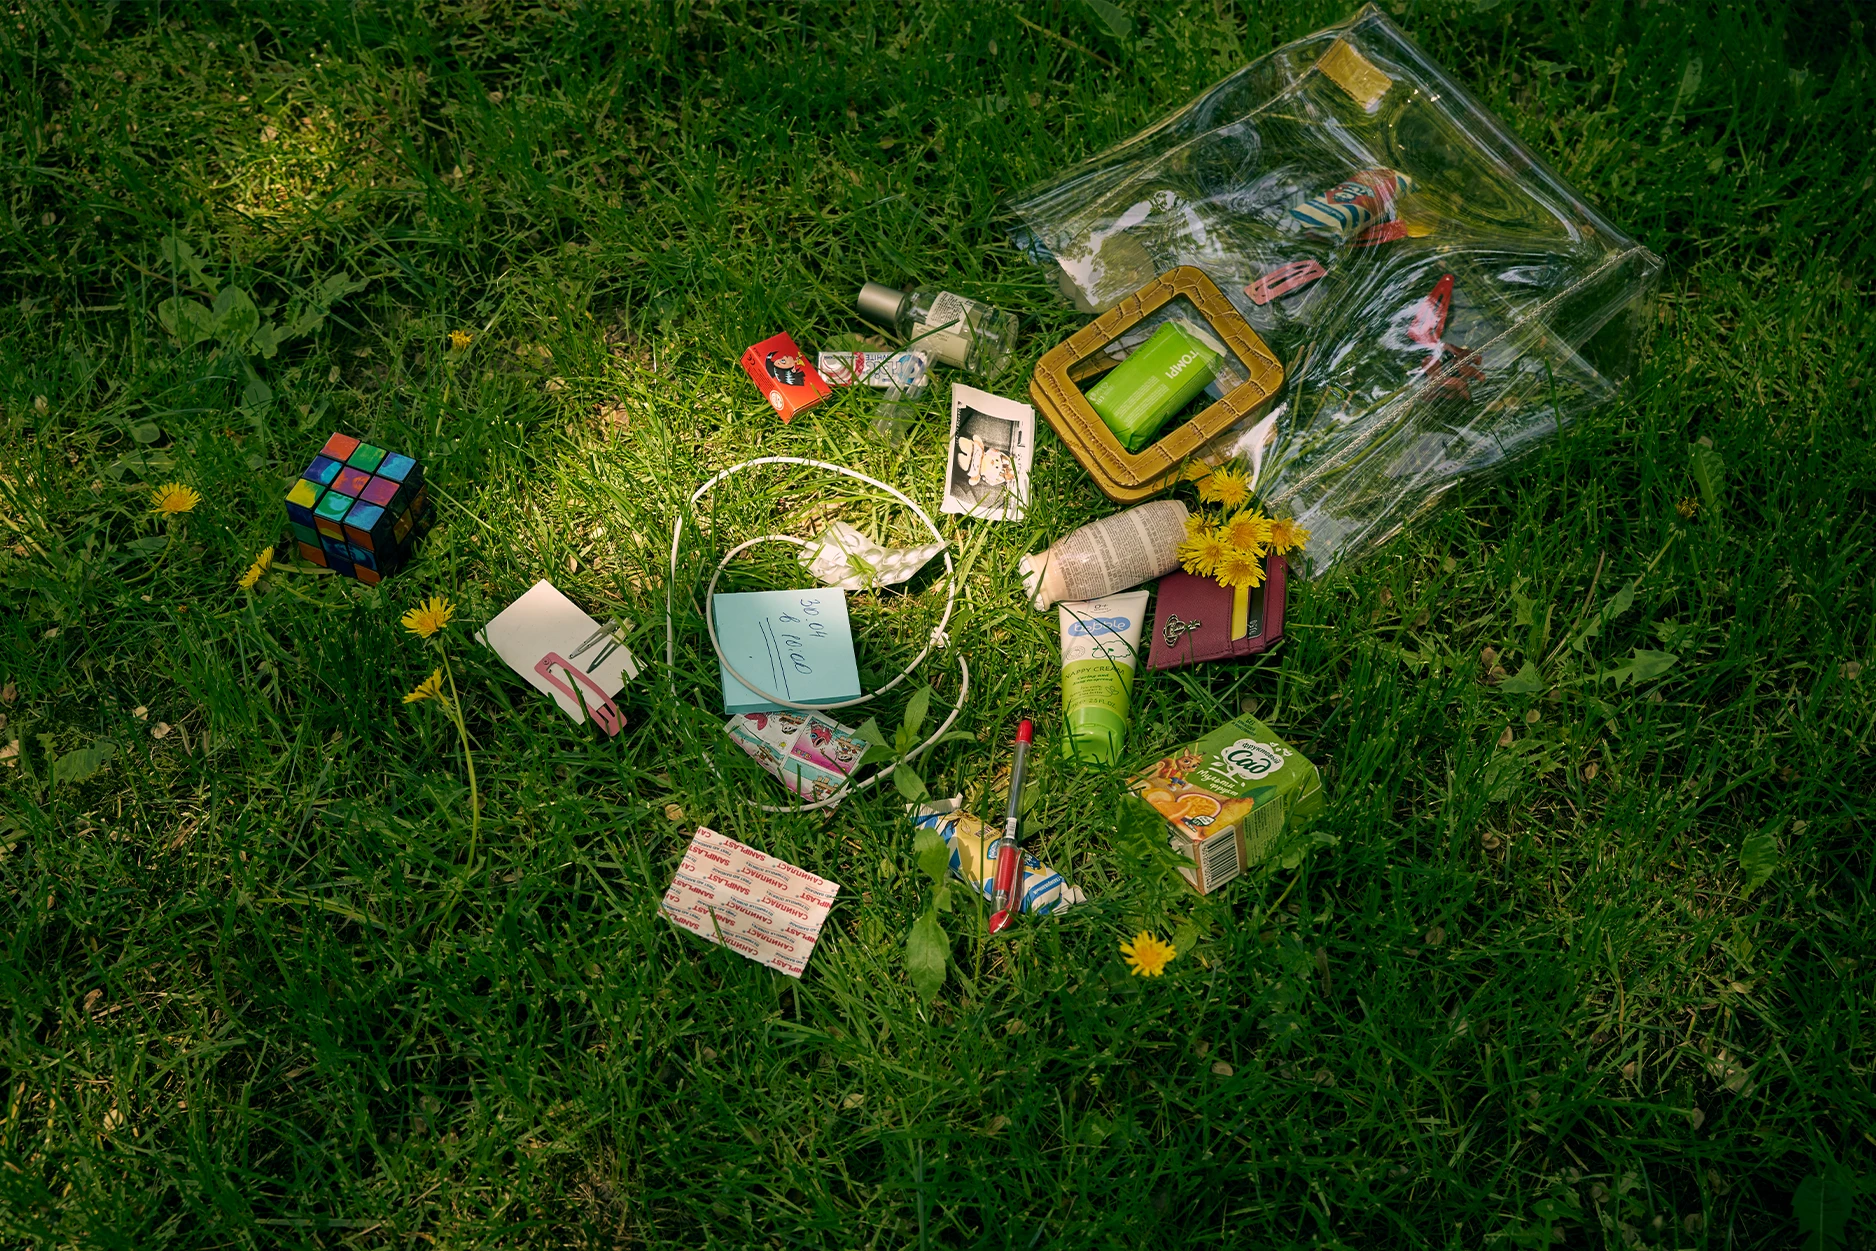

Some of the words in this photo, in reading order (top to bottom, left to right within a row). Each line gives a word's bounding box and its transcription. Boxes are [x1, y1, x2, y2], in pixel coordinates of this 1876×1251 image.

[1165, 350, 1199, 380] TOMPI
[800, 599, 828, 638] 30.04
[1074, 620, 1126, 633] bebble
[1065, 667, 1091, 680] NAPPY
[1093, 666, 1125, 675] CREAM
[1227, 750, 1272, 774] Сад
[1242, 743, 1281, 764] фруктовый
[1197, 769, 1235, 789] Мульти
[1209, 783, 1239, 797] фрукт
[689, 845, 730, 866] SANIPLAST
[724, 840, 765, 861] SANIPLAST
[708, 874, 750, 895] SANIPLAST
[742, 867, 788, 890] САНИПЛАСТ
[777, 864, 823, 885] САНИПЛАСТ
[673, 879, 714, 899] SANIPLAST
[726, 902, 772, 924] САНИПЛАСТ
[762, 897, 808, 920] САНИПЛАСТ
[748, 930, 794, 952] САНИПЛАСТ
